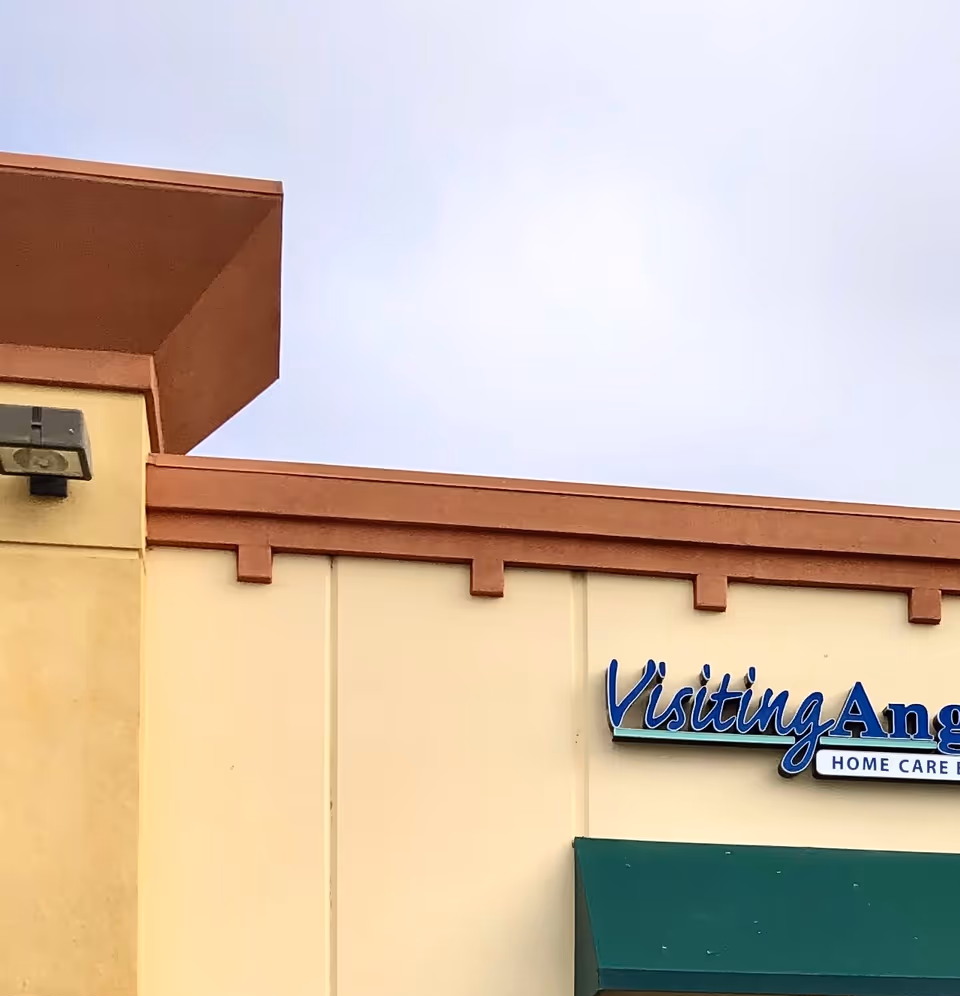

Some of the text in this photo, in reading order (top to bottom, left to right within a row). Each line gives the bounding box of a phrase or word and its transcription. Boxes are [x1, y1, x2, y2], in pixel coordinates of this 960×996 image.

[605, 658, 834, 775] Visiting
[831, 755, 891, 774] HOME
[899, 758, 952, 777] CARE
